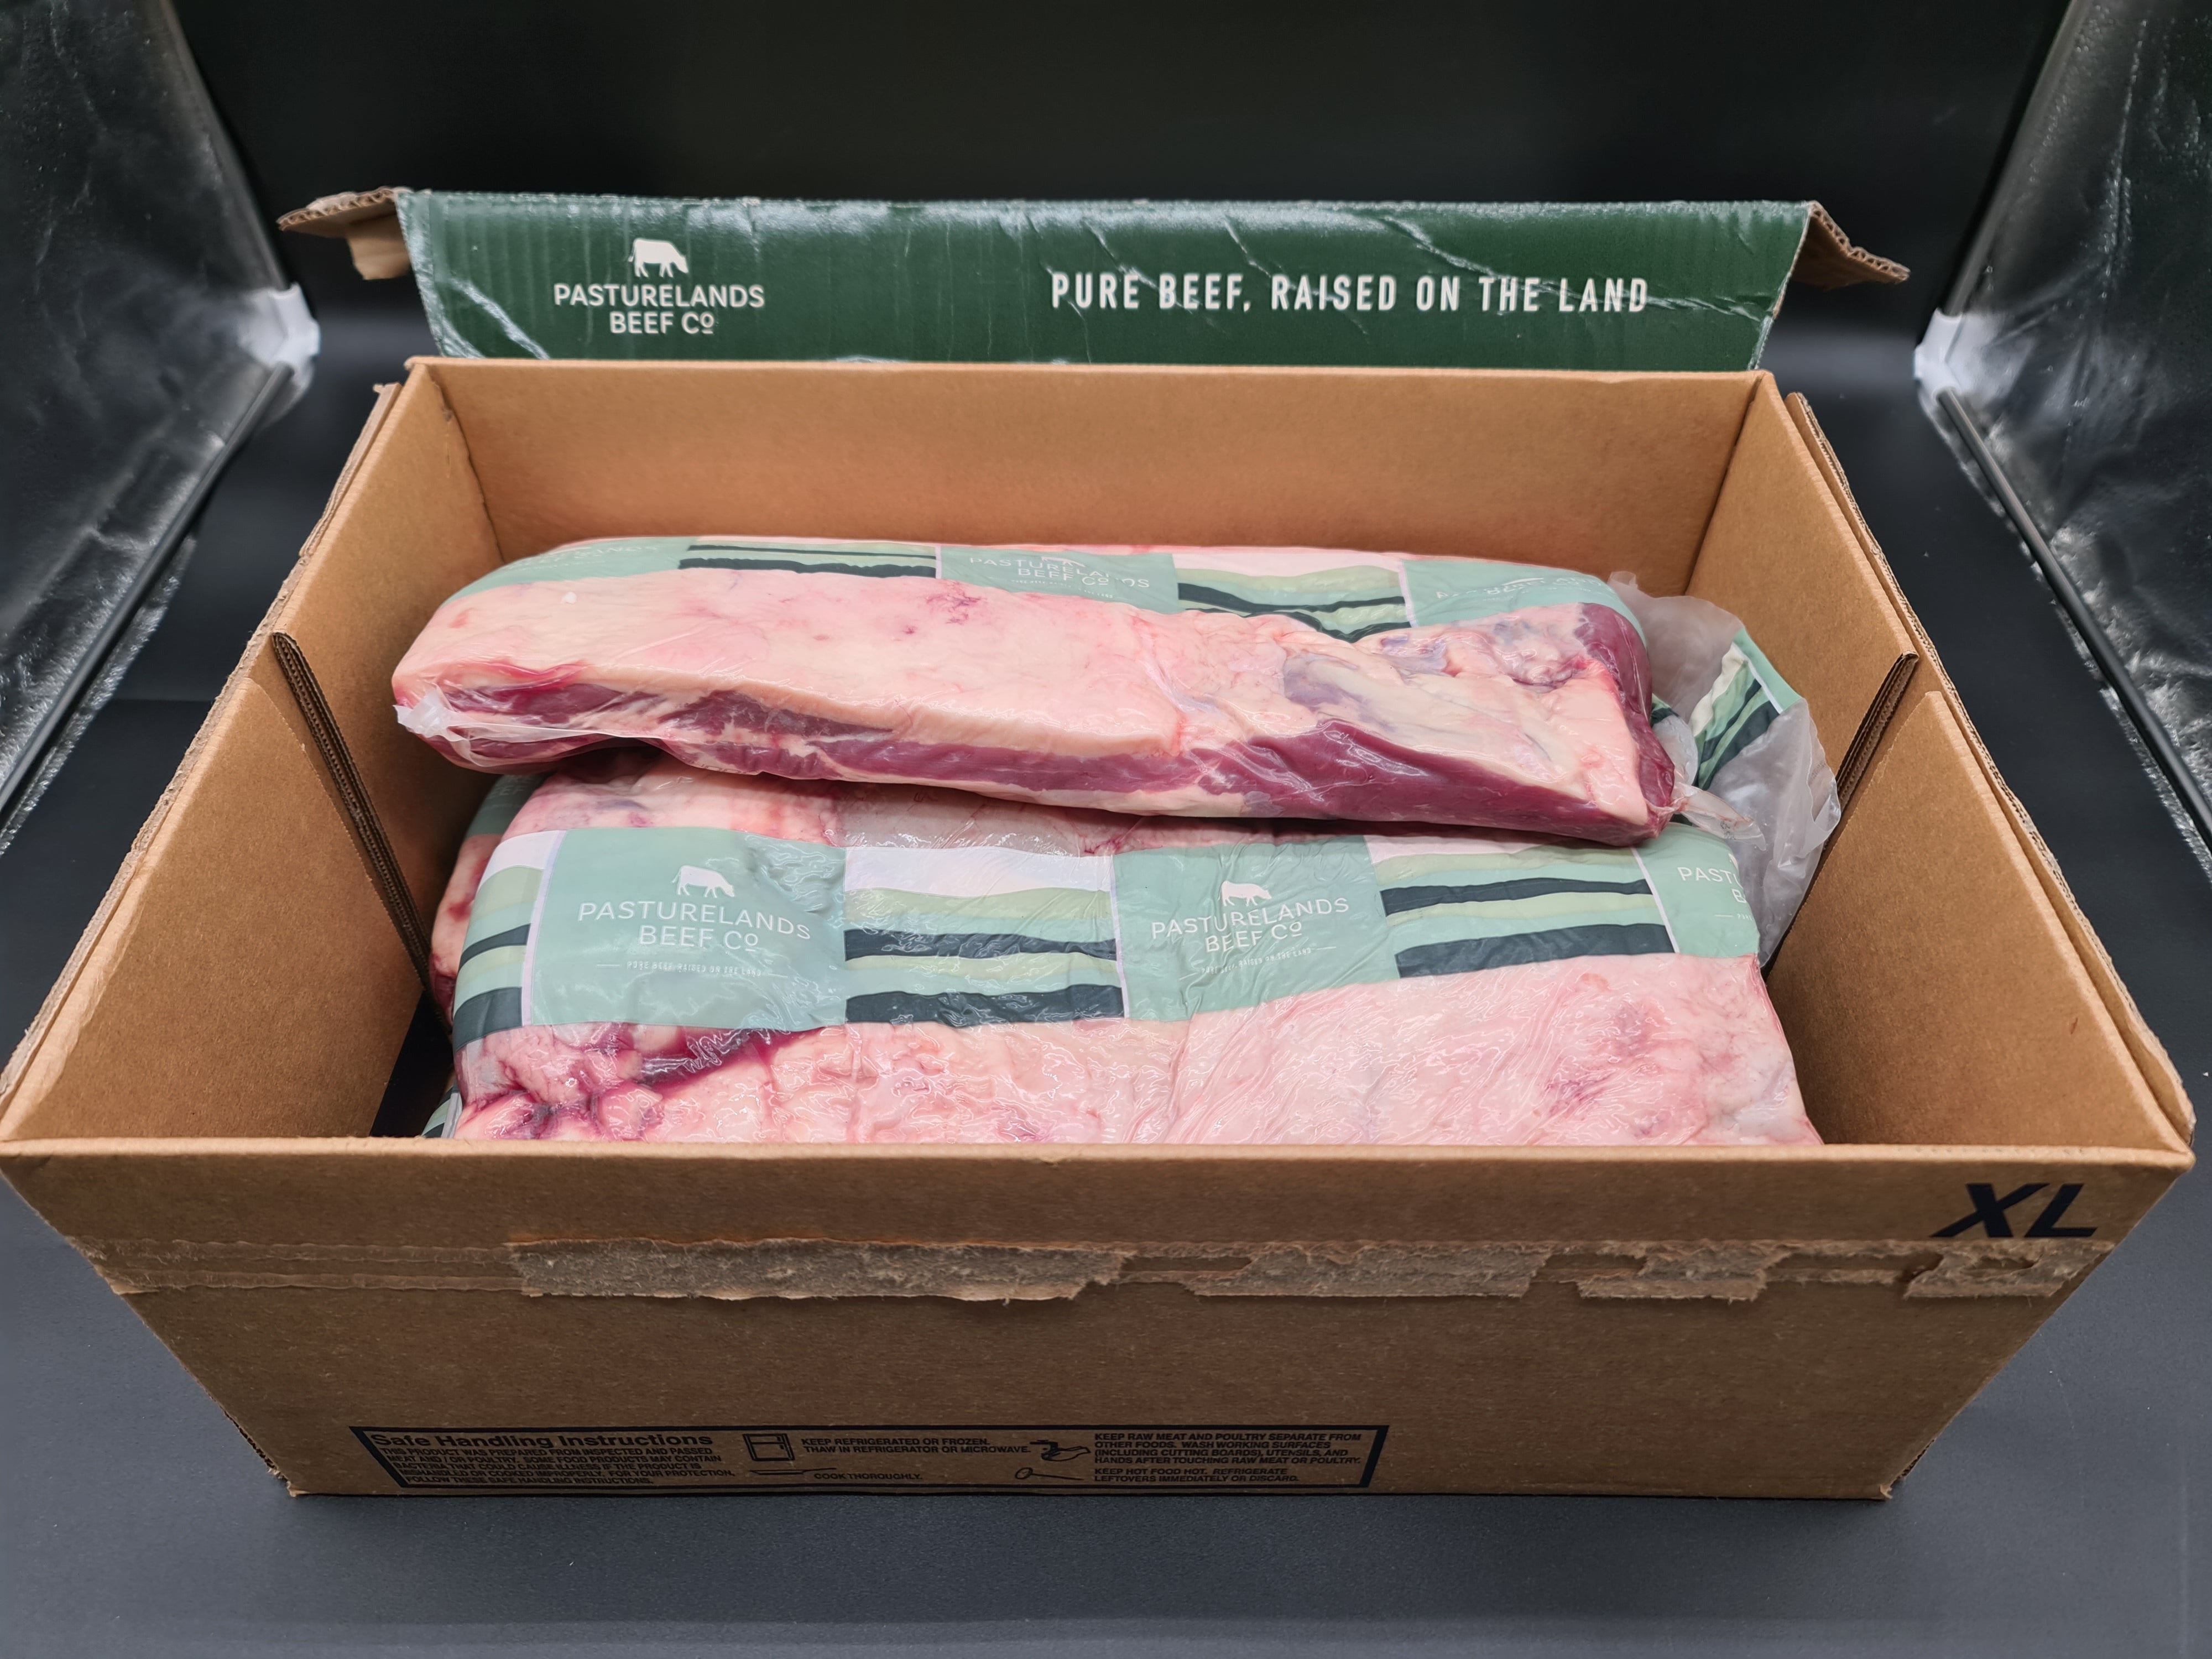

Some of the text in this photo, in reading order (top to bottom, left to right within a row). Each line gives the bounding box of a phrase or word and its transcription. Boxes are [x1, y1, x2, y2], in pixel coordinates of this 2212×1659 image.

[554, 284, 765, 309] PASTURELANDS
[1052, 273, 1648, 312] PURE BEEF, RAISED ON THE LAND
[609, 311, 674, 333] BEEF
[969, 557, 1150, 588] PASTURELADS
[578, 901, 811, 940] PASTURELANDS
[1151, 897, 1350, 940] PASTURELANDS
[638, 925, 714, 948] BEEF
[1204, 930, 1262, 953] BEEF
[1929, 1183, 2098, 1238] XL
[371, 1434, 713, 1448] Safe Handling Instructions
